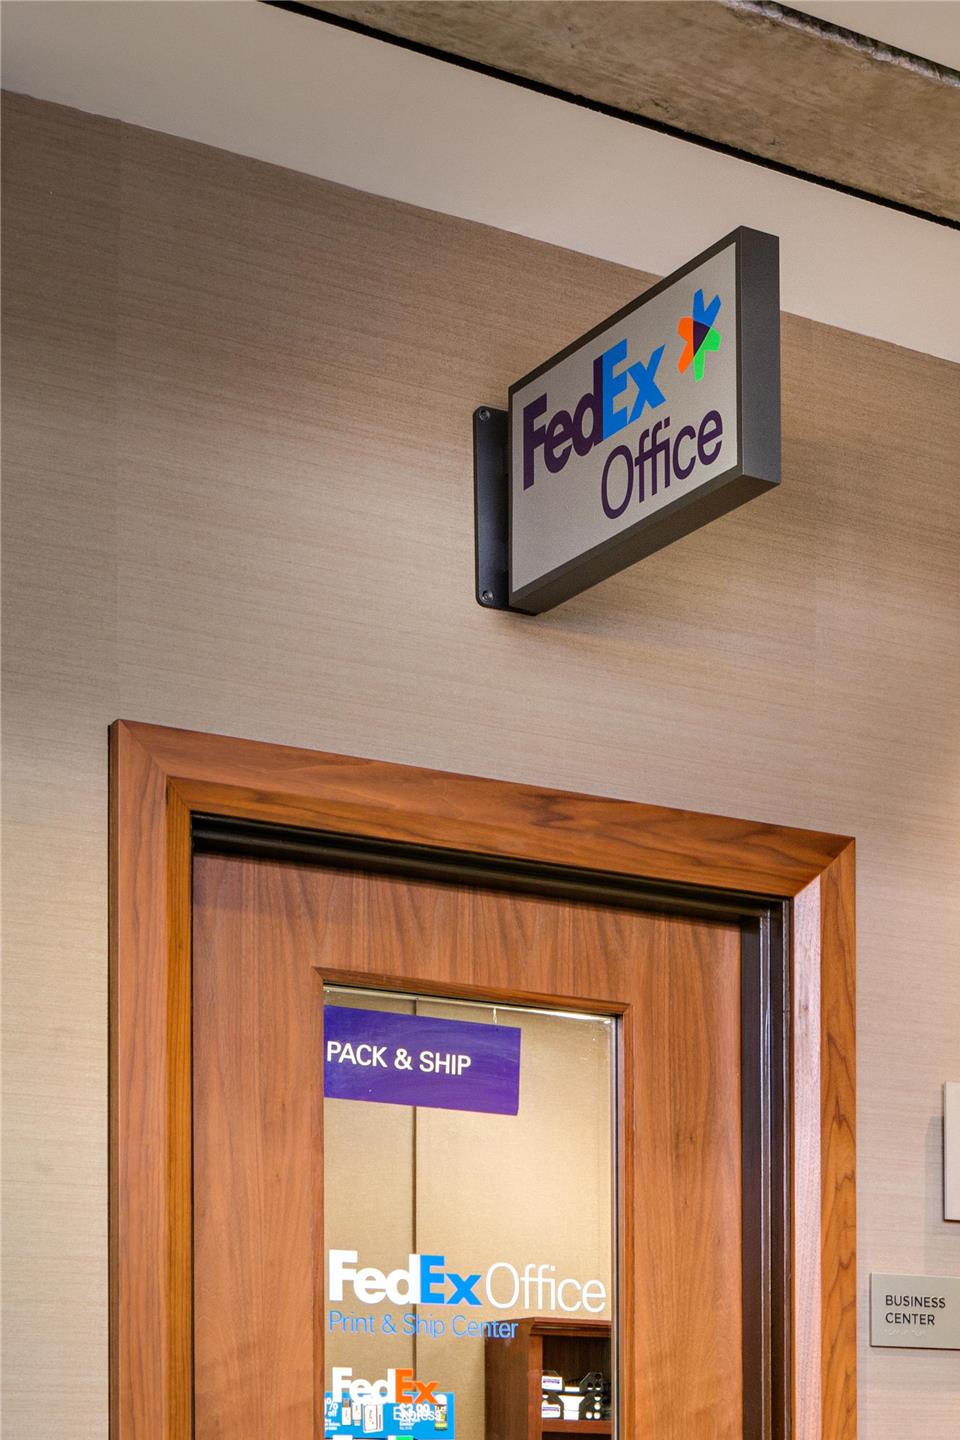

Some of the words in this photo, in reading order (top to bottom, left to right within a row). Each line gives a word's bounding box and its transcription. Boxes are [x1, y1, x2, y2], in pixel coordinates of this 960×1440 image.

[523, 338, 666, 490] FedEx
[601, 409, 723, 520] Office
[326, 1041, 387, 1068] PACK
[394, 1047, 413, 1071] &
[419, 1050, 472, 1076] SHIP
[328, 1248, 482, 1306] FedEx
[485, 1261, 607, 1313] Office
[885, 1294, 946, 1309] BUSINESS
[885, 1312, 936, 1326] CENTER
[329, 1311, 375, 1335] Print
[381, 1314, 399, 1335] &
[402, 1313, 446, 1339] Ship
[451, 1315, 518, 1339] Center
[332, 1367, 439, 1405] FedEx
[393, 1406, 441, 1423] Express
